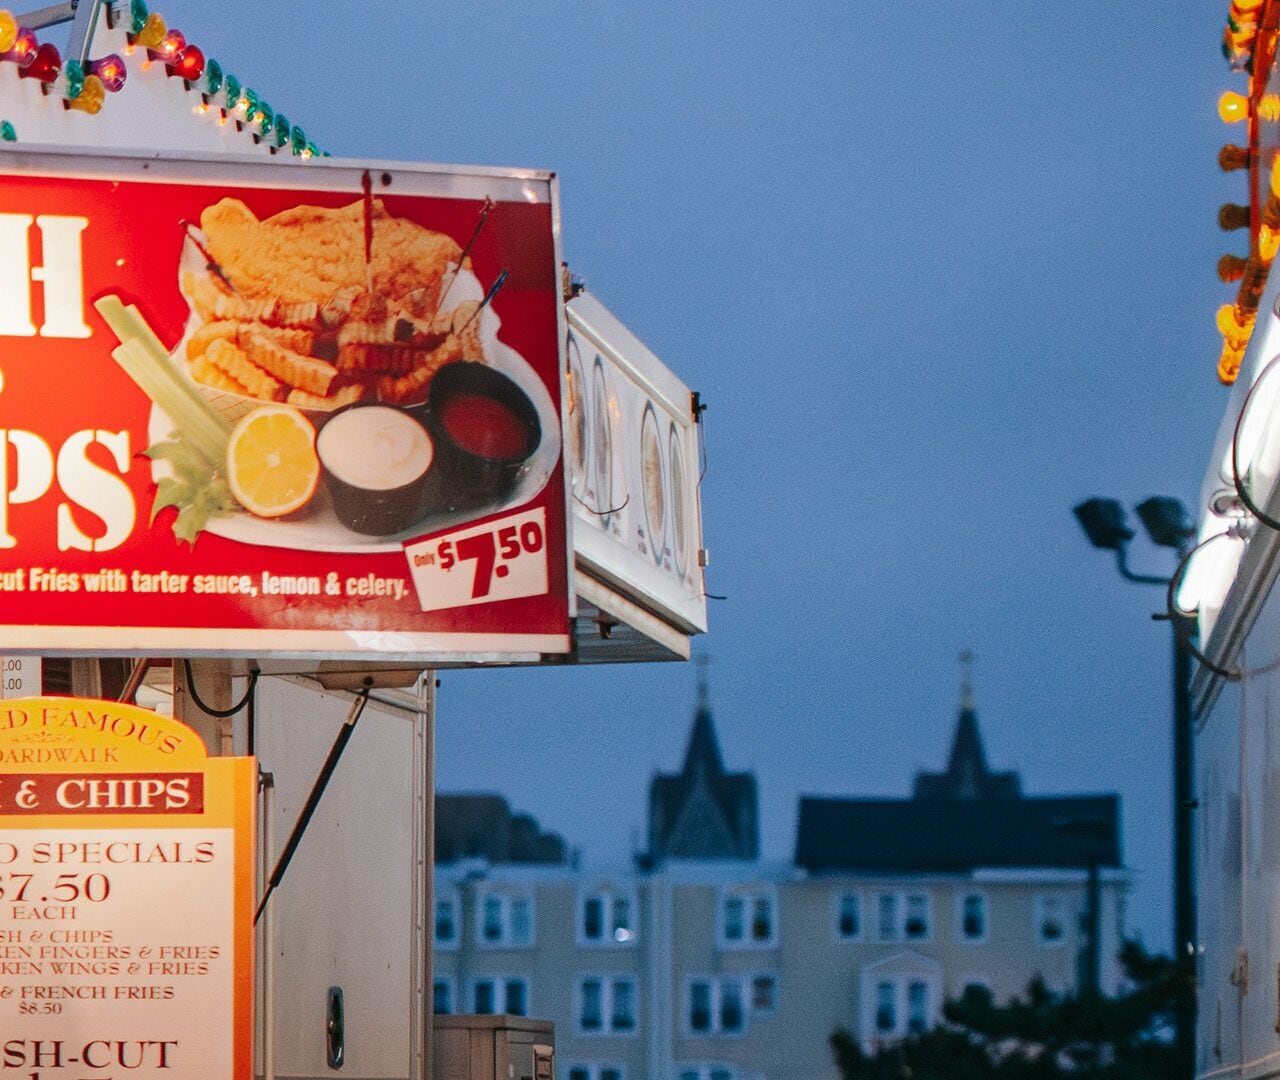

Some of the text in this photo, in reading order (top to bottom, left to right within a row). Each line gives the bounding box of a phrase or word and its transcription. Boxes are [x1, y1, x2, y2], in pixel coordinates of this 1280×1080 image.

[29, 567, 80, 592] Fries
[84, 568, 128, 593] with
[131, 570, 189, 593] tarter
[193, 573, 258, 597] sauce,
[262, 571, 321, 596] lemon
[325, 572, 341, 596] &
[346, 573, 409, 600] celery.
[42, 706, 183, 756] FAMOUS
[14, 780, 40, 809] &
[55, 777, 191, 810] CHIPS
[32, 840, 216, 865] SPECIALS
[11, 906, 77, 920] EACH
[29, 930, 44, 943] &
[49, 929, 114, 943] CHIPS
[40, 946, 132, 960] FINGERS
[138, 946, 152, 960] &
[160, 945, 221, 960] FRIES
[49, 962, 120, 975] WINGS
[127, 962, 140, 975] &
[148, 962, 210, 975] FRIES
[0, 986, 14, 999] &
[20, 985, 107, 999] FRENCH
[113, 985, 176, 999] FRIES
[18, 1001, 63, 1016] $8.50
